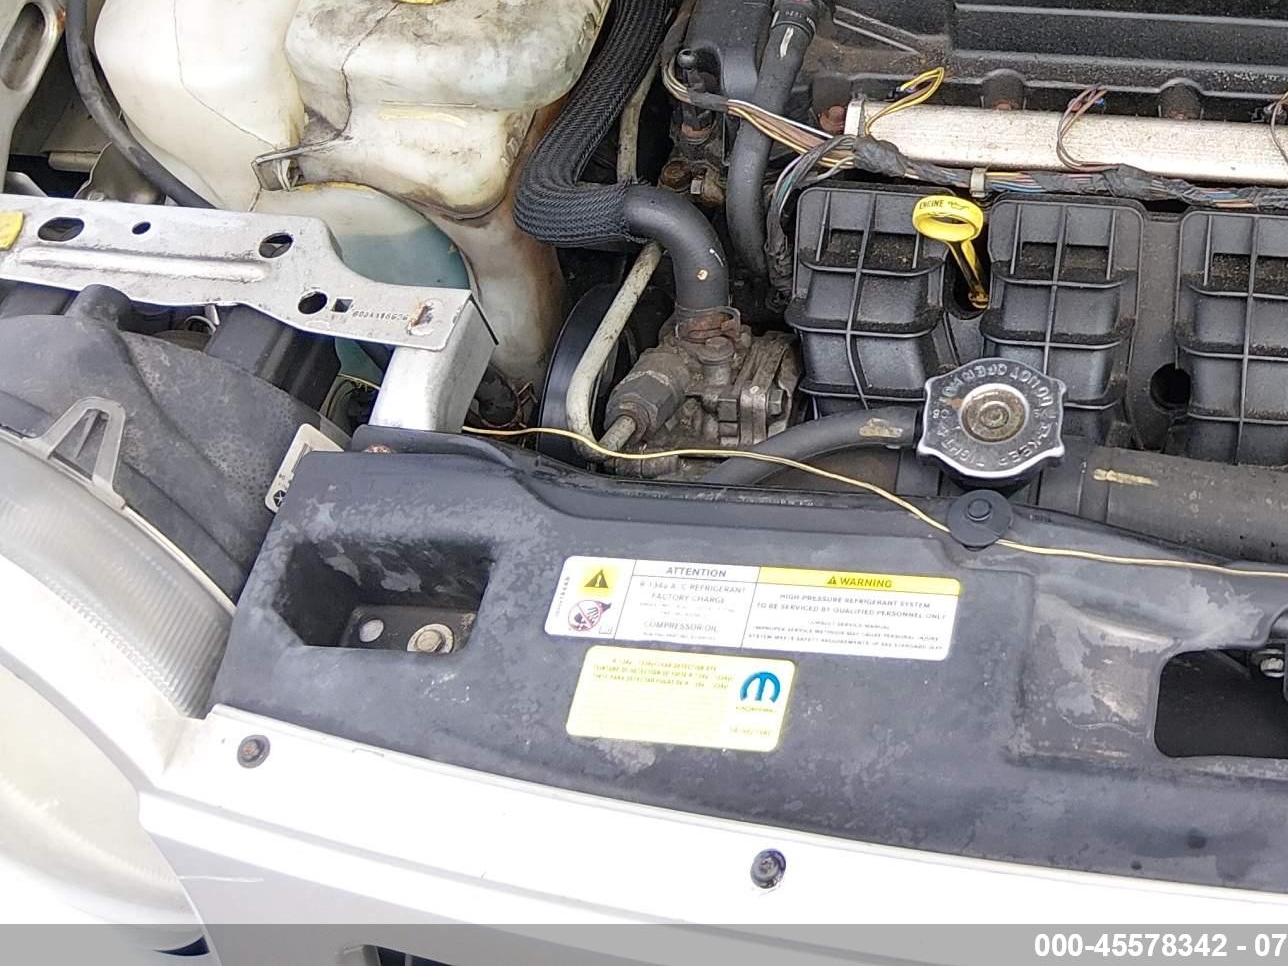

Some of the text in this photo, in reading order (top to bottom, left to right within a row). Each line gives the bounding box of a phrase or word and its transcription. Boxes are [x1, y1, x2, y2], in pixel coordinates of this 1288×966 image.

[919, 199, 945, 210] ENGINE
[665, 566, 727, 578] ATTENTION
[840, 576, 893, 589] WARNING
[689, 584, 747, 594] REFRIGERANT
[651, 592, 725, 604] FACTORY CHARGE
[801, 595, 842, 603] PRESSURE
[844, 597, 898, 607] REFRIGERANT
[899, 601, 931, 609] SYSTEM
[780, 604, 819, 612] SERVICED
[832, 607, 875, 616] QUALIFIED
[876, 610, 922, 619] PERSONNEL
[643, 619, 703, 632] COMPRESSOR
